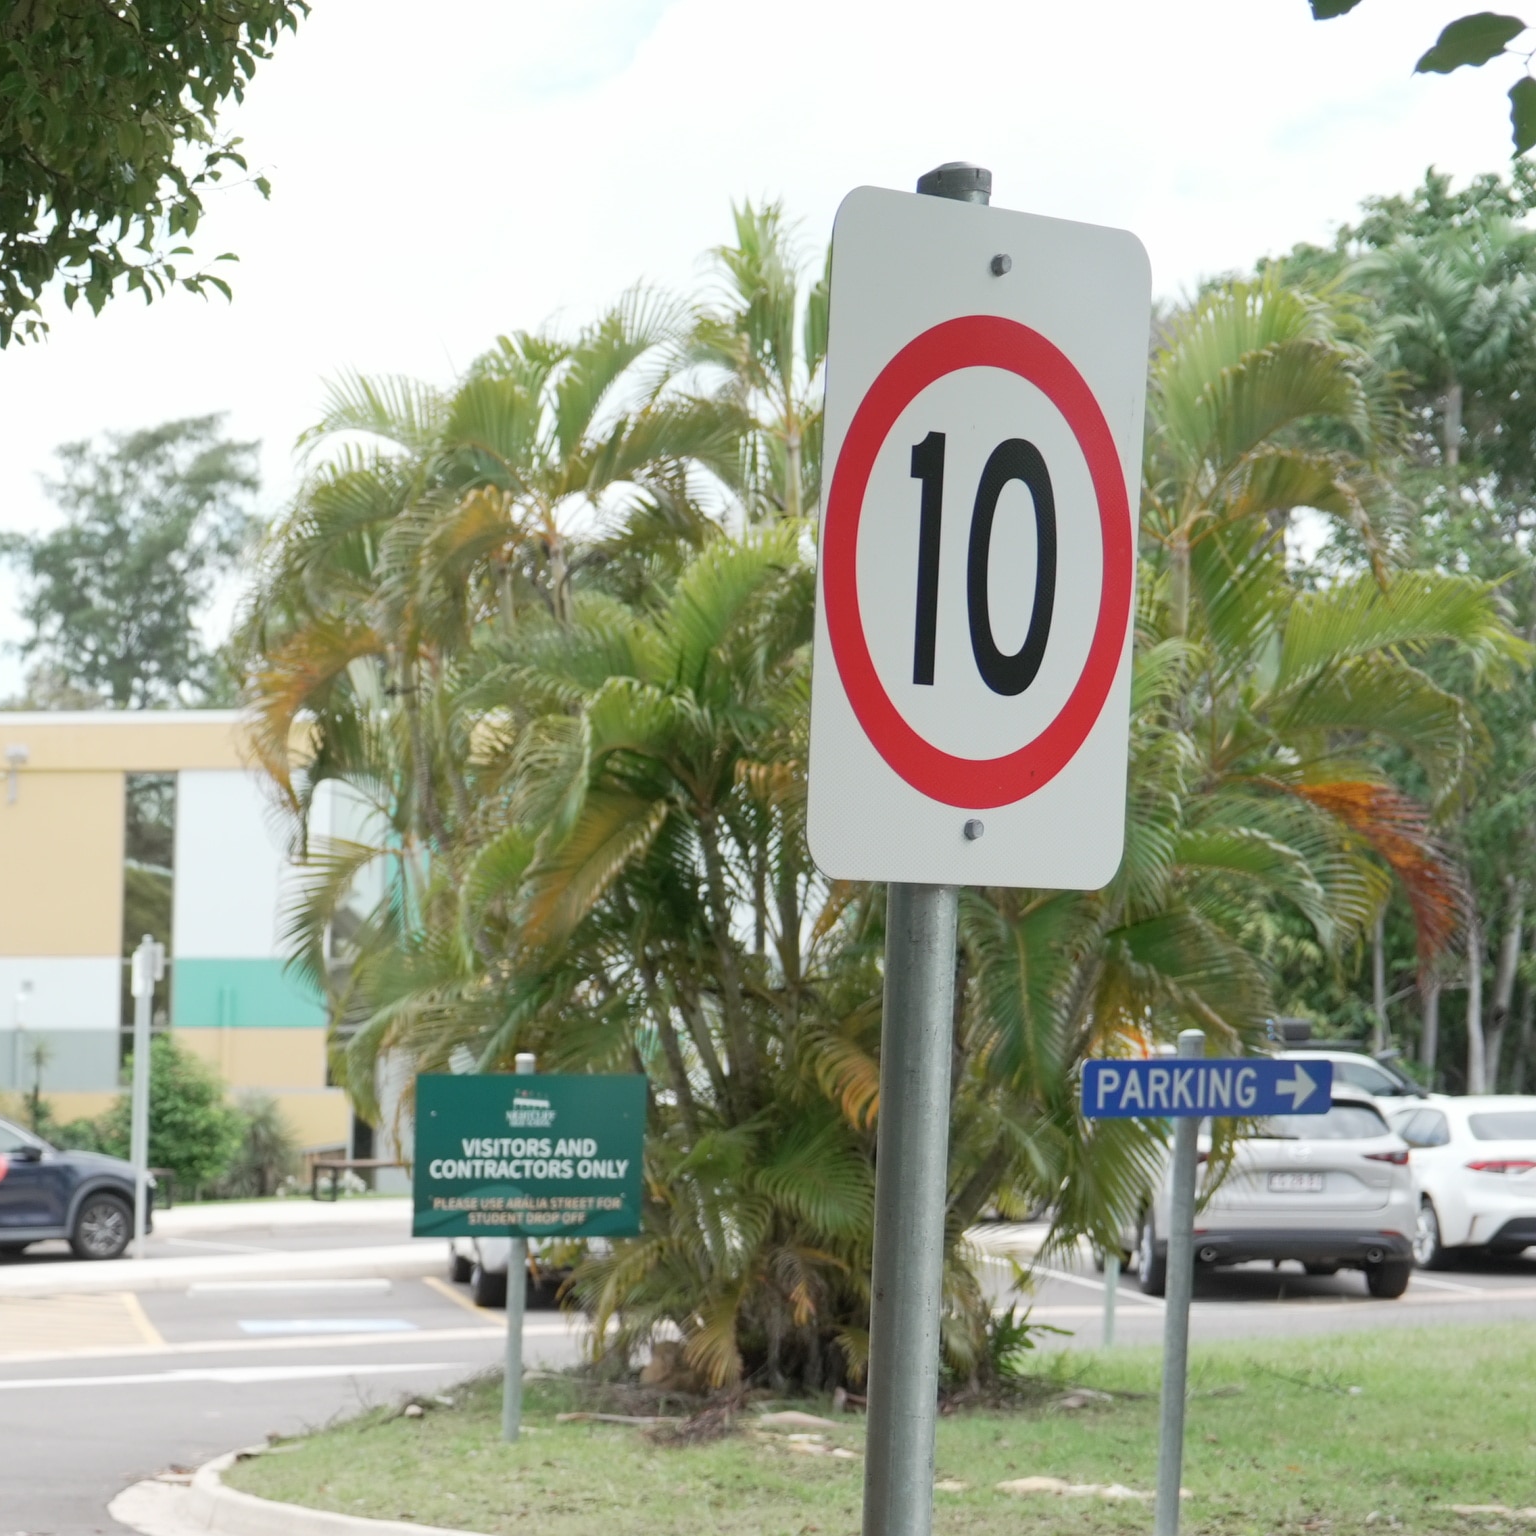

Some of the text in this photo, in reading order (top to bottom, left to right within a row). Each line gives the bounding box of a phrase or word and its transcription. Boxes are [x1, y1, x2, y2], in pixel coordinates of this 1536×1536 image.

[910, 431, 1057, 696] 10
[1096, 1067, 1258, 1110] PARKING
[461, 1137, 598, 1158] VISITORS AND
[429, 1159, 629, 1179] CONTRACTORS ONLY
[433, 1197, 623, 1211] PLEASE USE ARALIA STREET FOR
[468, 1211, 587, 1226] STUDENT DROP OFF
